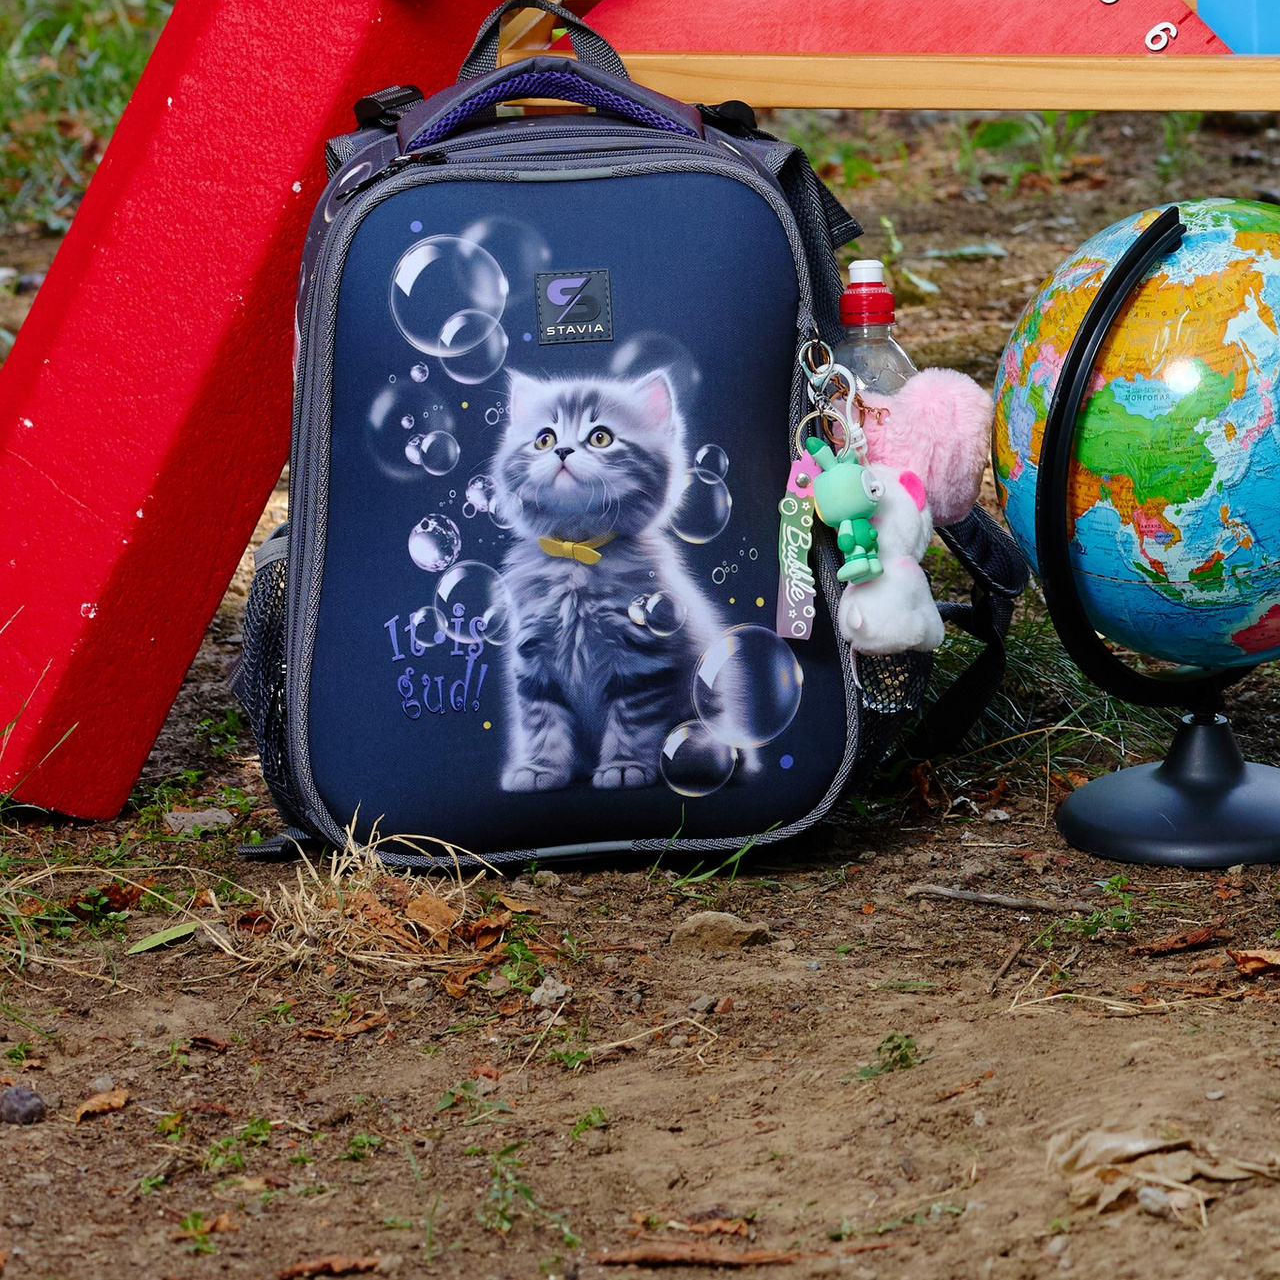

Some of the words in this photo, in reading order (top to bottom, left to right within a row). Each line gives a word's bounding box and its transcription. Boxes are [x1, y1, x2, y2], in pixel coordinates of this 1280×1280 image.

[1143, 20, 1179, 52] 6
[546, 323, 604, 336] STAVIA
[1124, 393, 1171, 402] МОНГОЛИЯ
[786, 525, 817, 602] Bubble
[383, 611, 426, 662] It
[450, 602, 488, 660] is
